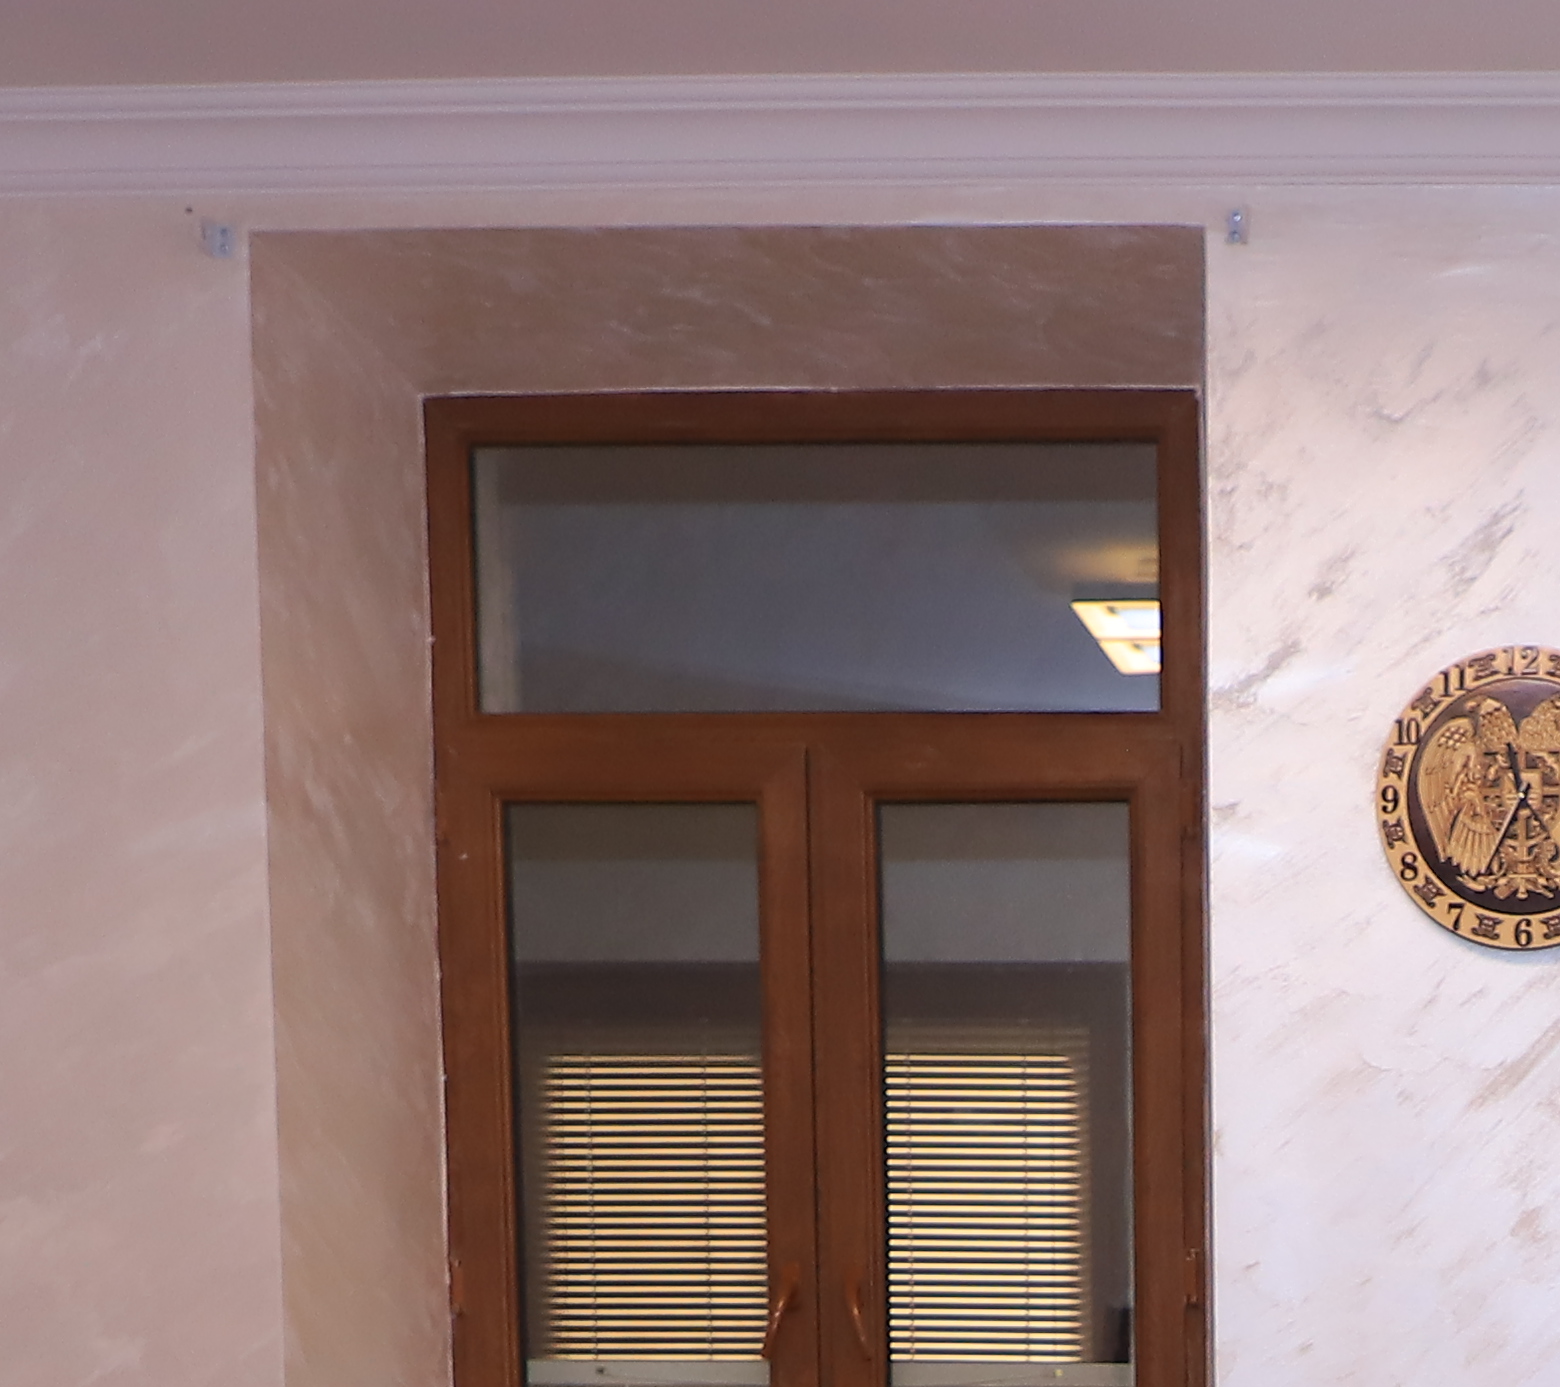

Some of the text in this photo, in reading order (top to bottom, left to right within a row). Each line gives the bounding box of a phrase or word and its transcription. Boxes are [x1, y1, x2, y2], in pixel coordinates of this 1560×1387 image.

[1506, 646, 1539, 677] 12
[1440, 664, 1466, 696] 11
[1394, 718, 1420, 746] 10
[1382, 786, 1400, 813] 9
[1400, 854, 1418, 881] 8
[1447, 903, 1465, 931] 7
[1514, 918, 1532, 947] 6
